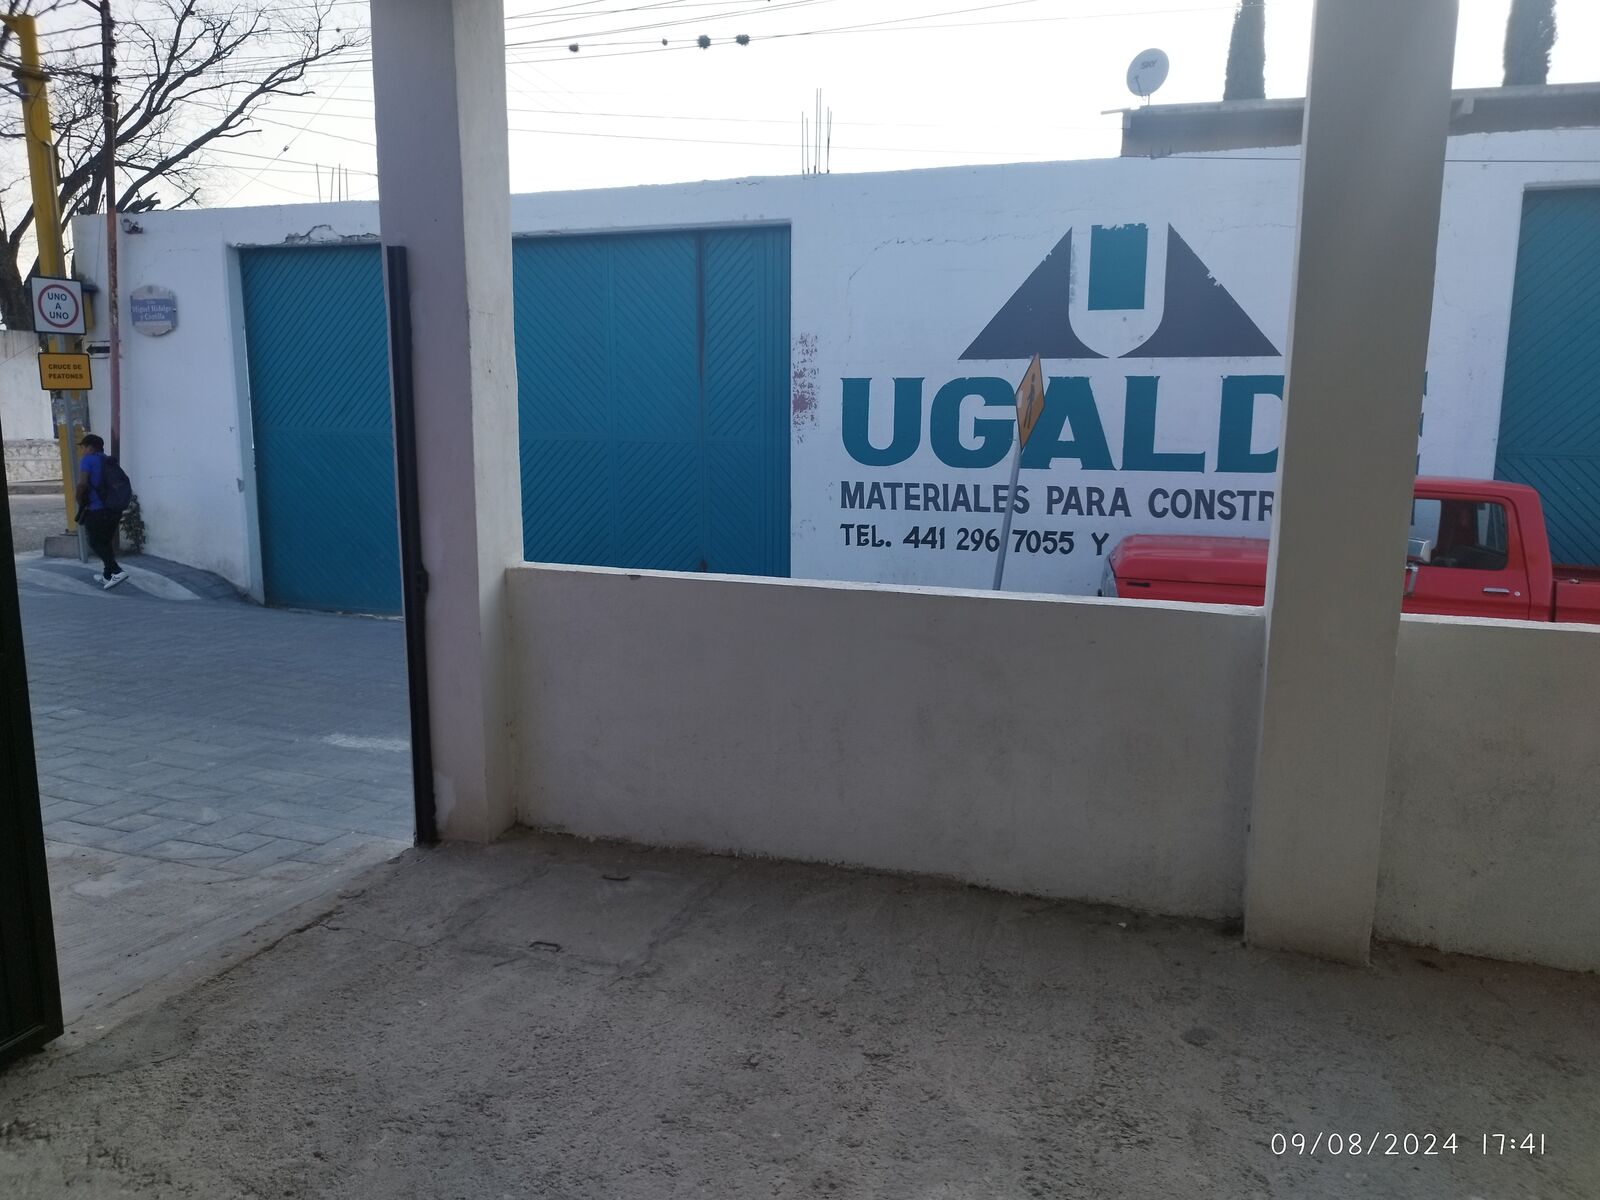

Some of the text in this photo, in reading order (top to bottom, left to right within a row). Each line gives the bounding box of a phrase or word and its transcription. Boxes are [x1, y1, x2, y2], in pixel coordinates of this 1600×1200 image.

[47, 293, 67, 302] UNO
[55, 302, 62, 310] A
[49, 311, 69, 320] UNO
[840, 375, 1284, 473] UGALD
[840, 481, 1275, 521] MATERIALES PARA CONSTR
[840, 523, 1110, 556] TEL. 441 296 7055 Y
